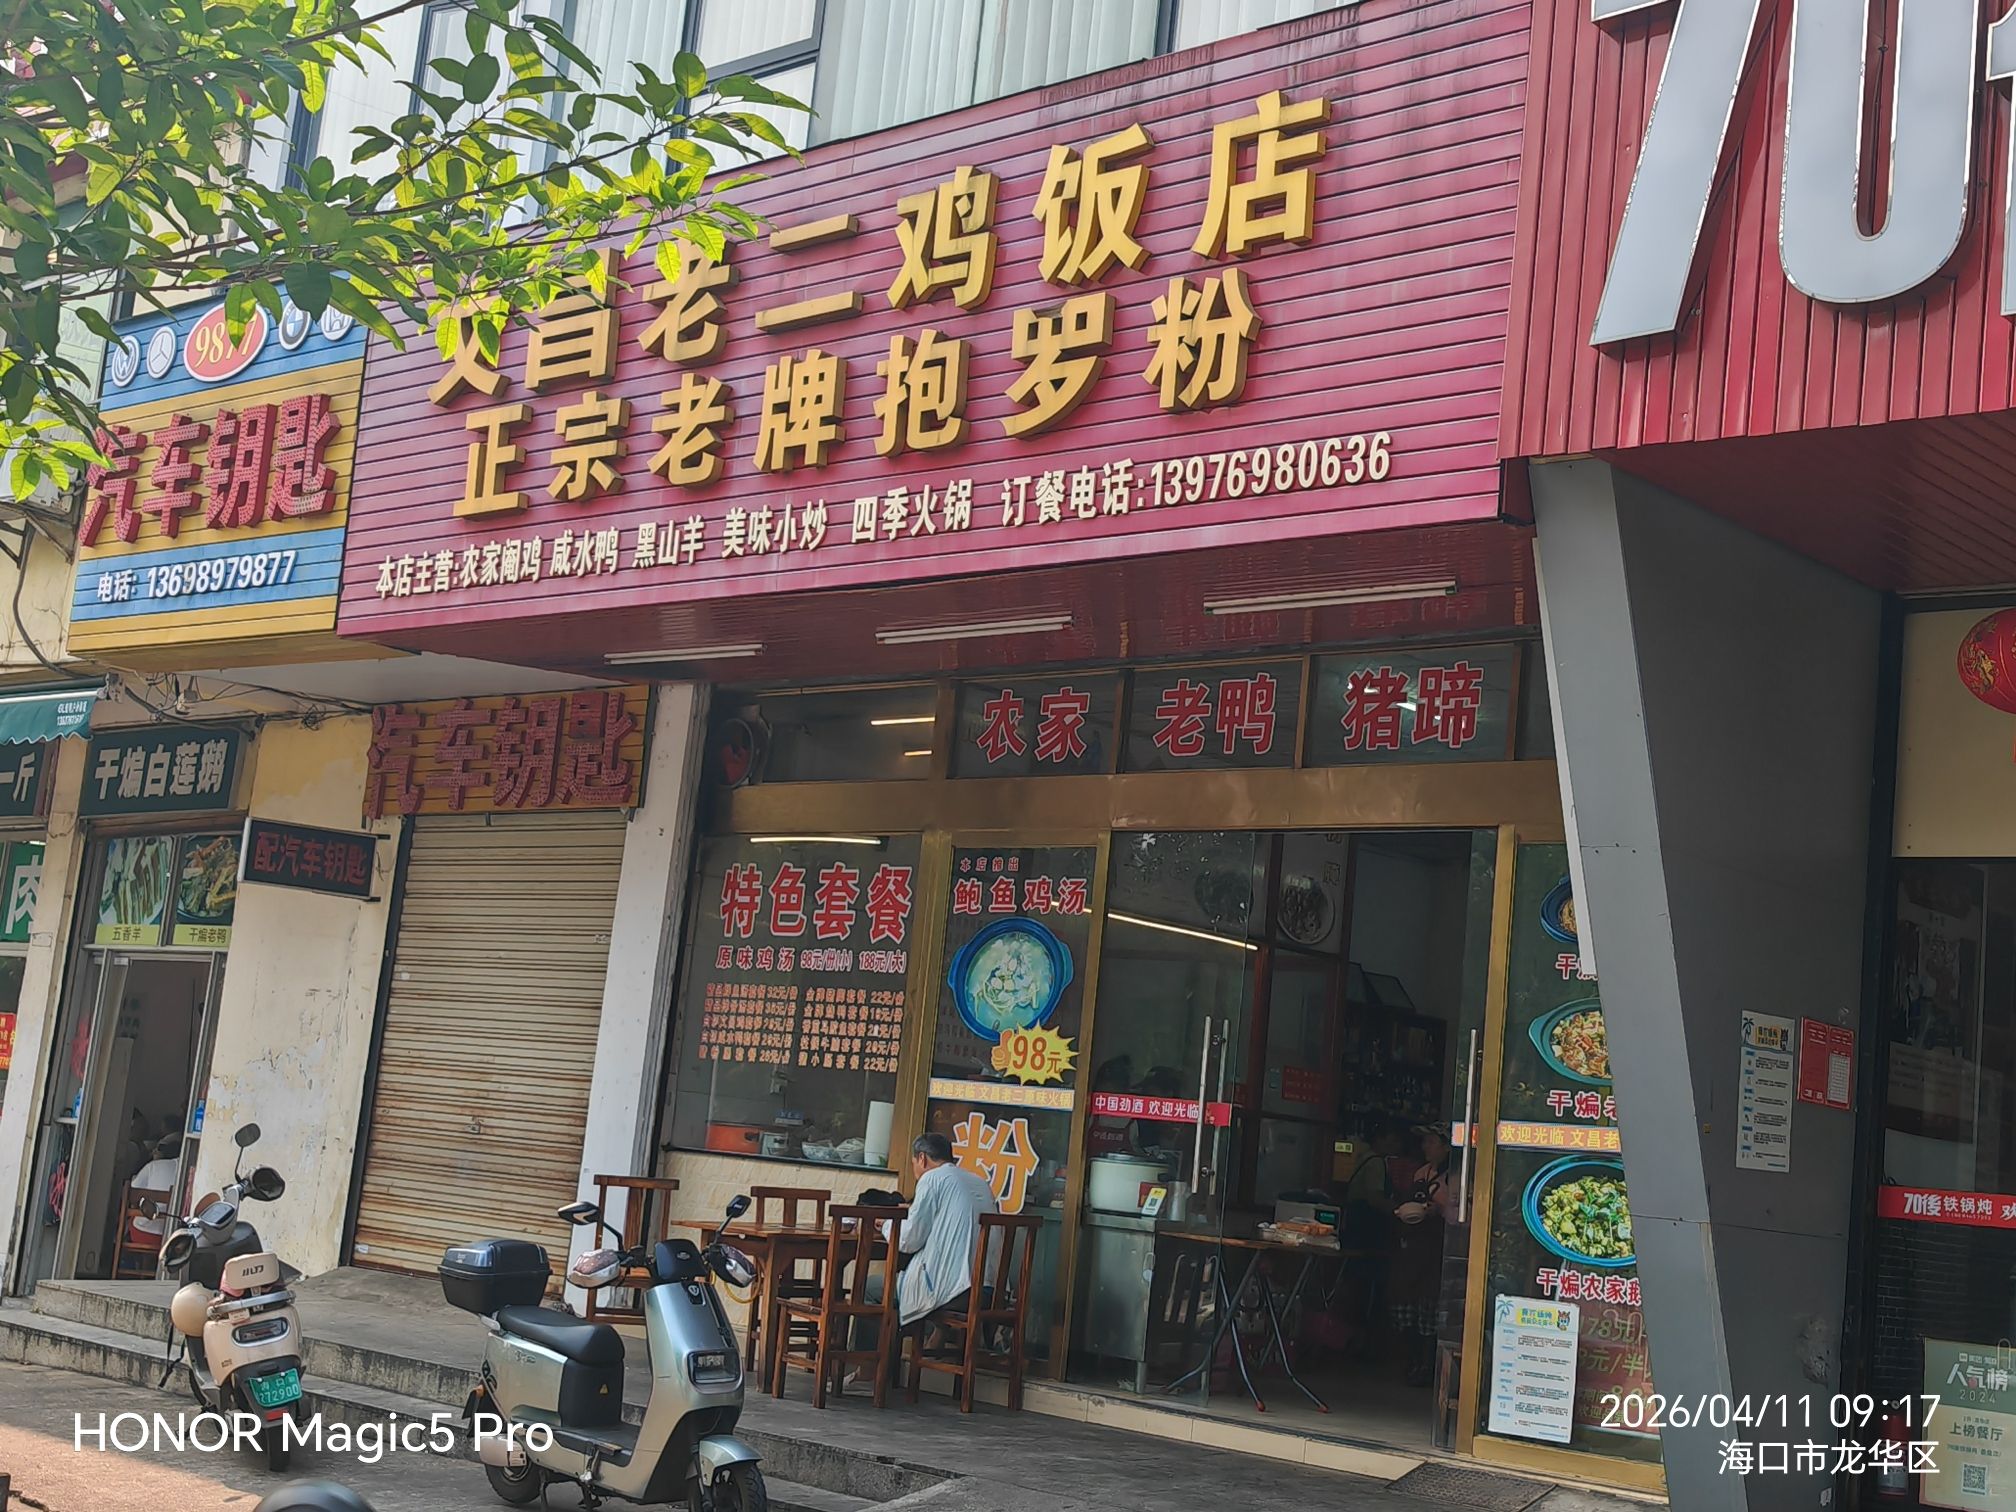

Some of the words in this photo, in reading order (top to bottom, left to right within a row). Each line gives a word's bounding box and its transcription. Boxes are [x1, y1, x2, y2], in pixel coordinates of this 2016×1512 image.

[1590, 0, 2016, 345] 70
[194, 313, 258, 369] 987
[453, 268, 1262, 519] 正宗老牌抱罗粉
[80, 393, 341, 548] 汽车钥匙
[549, 525, 620, 578] 咸水鸭
[632, 514, 706, 569] 黑山羊
[721, 498, 828, 559] 美味小炒
[852, 478, 973, 544] 四季火锅
[1000, 430, 1393, 528] 订餐电话:13976980636
[146, 550, 297, 598] 13698979877
[976, 686, 1089, 763] 农家
[1153, 672, 1277, 757] 老鸭
[1343, 661, 1484, 750] 猪蹄
[367, 690, 638, 820] 汽车钥匙
[253, 830, 369, 886] 配汽车钥匙
[953, 875, 1087, 915] 鲍鱼鸡汤
[720, 861, 912, 944] 特色套餐
[715, 945, 795, 970] 原味鸡汤
[1012, 1035, 1061, 1074] 98元
[1095, 1095, 1143, 1114] 中国劲酒
[1148, 1100, 1200, 1119] 欢迎光临
[1501, 1125, 1564, 1146] 欢迎光临
[1570, 1129, 1620, 1149] 文昌老
[952, 1112, 1039, 1214] 粉
[1960, 1390, 1996, 1403] 2024
